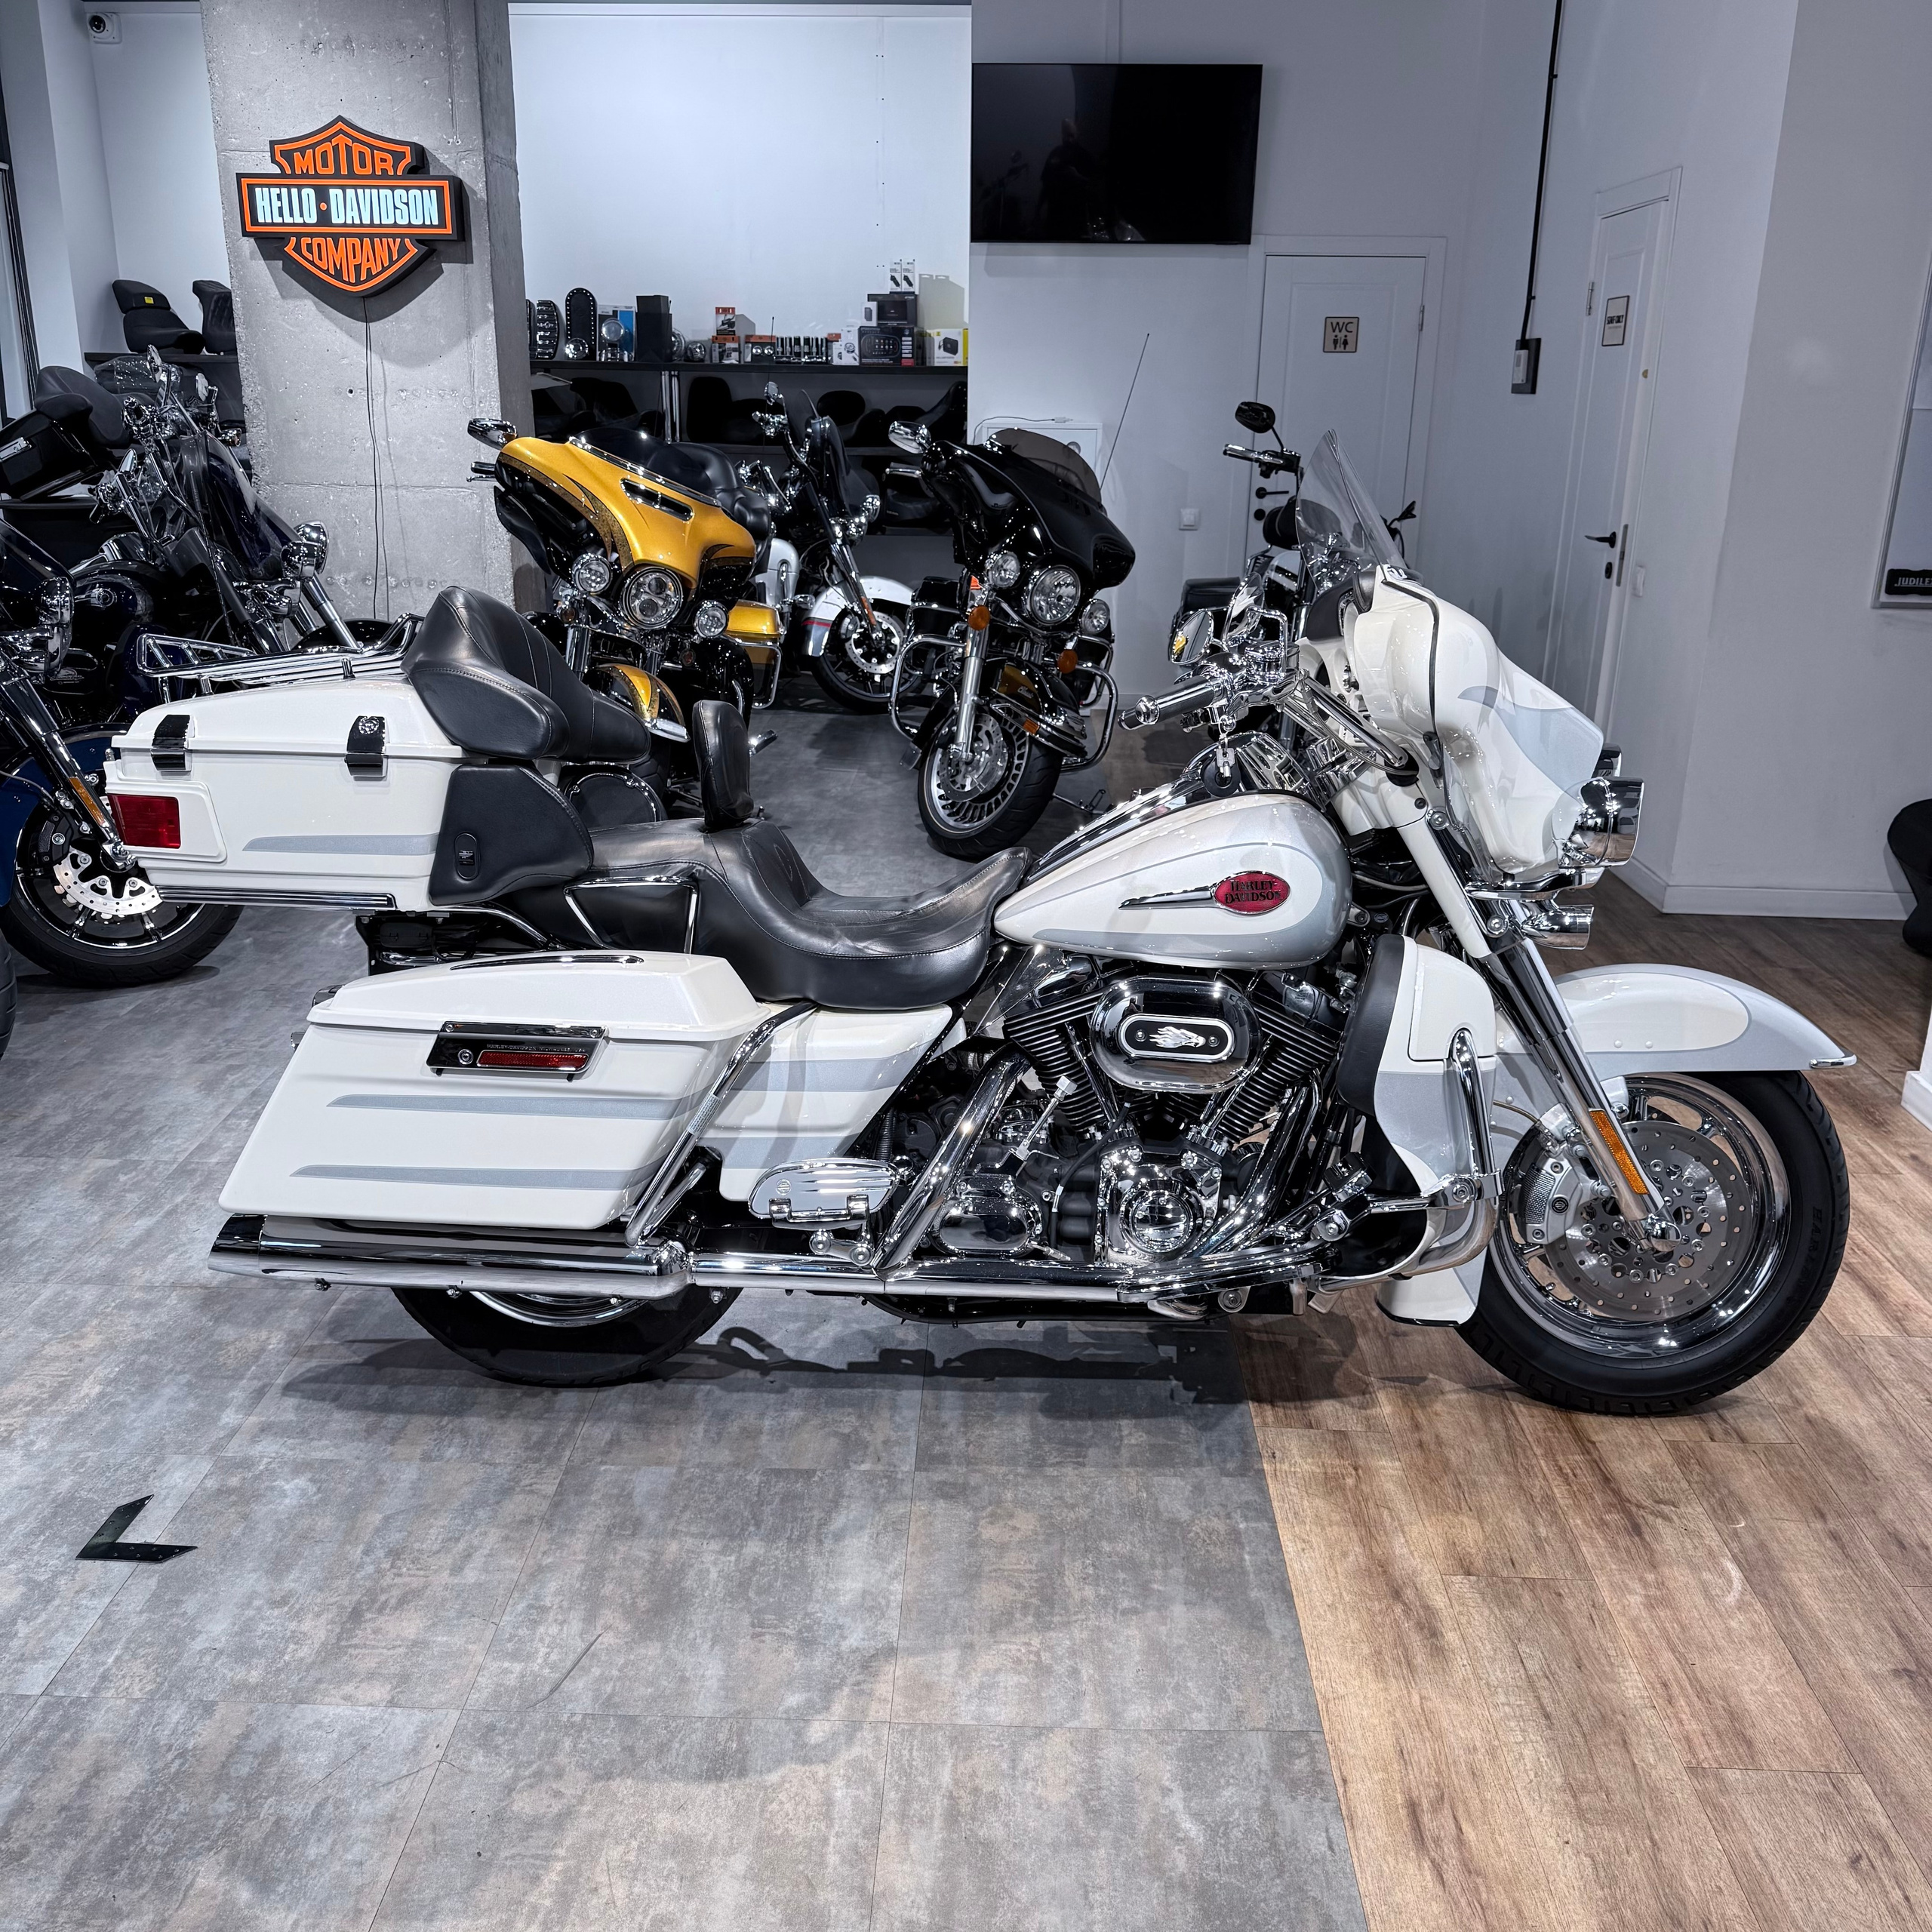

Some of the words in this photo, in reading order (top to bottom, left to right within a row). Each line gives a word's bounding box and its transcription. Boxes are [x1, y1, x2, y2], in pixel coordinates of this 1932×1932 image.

[293, 134, 394, 176] MOTOR
[254, 187, 317, 223] HELLO
[329, 188, 439, 226] DAVIDSON
[300, 237, 401, 284] COMPANY
[1331, 321, 1354, 333] WC
[1225, 891, 1281, 904] DAVIDSON
